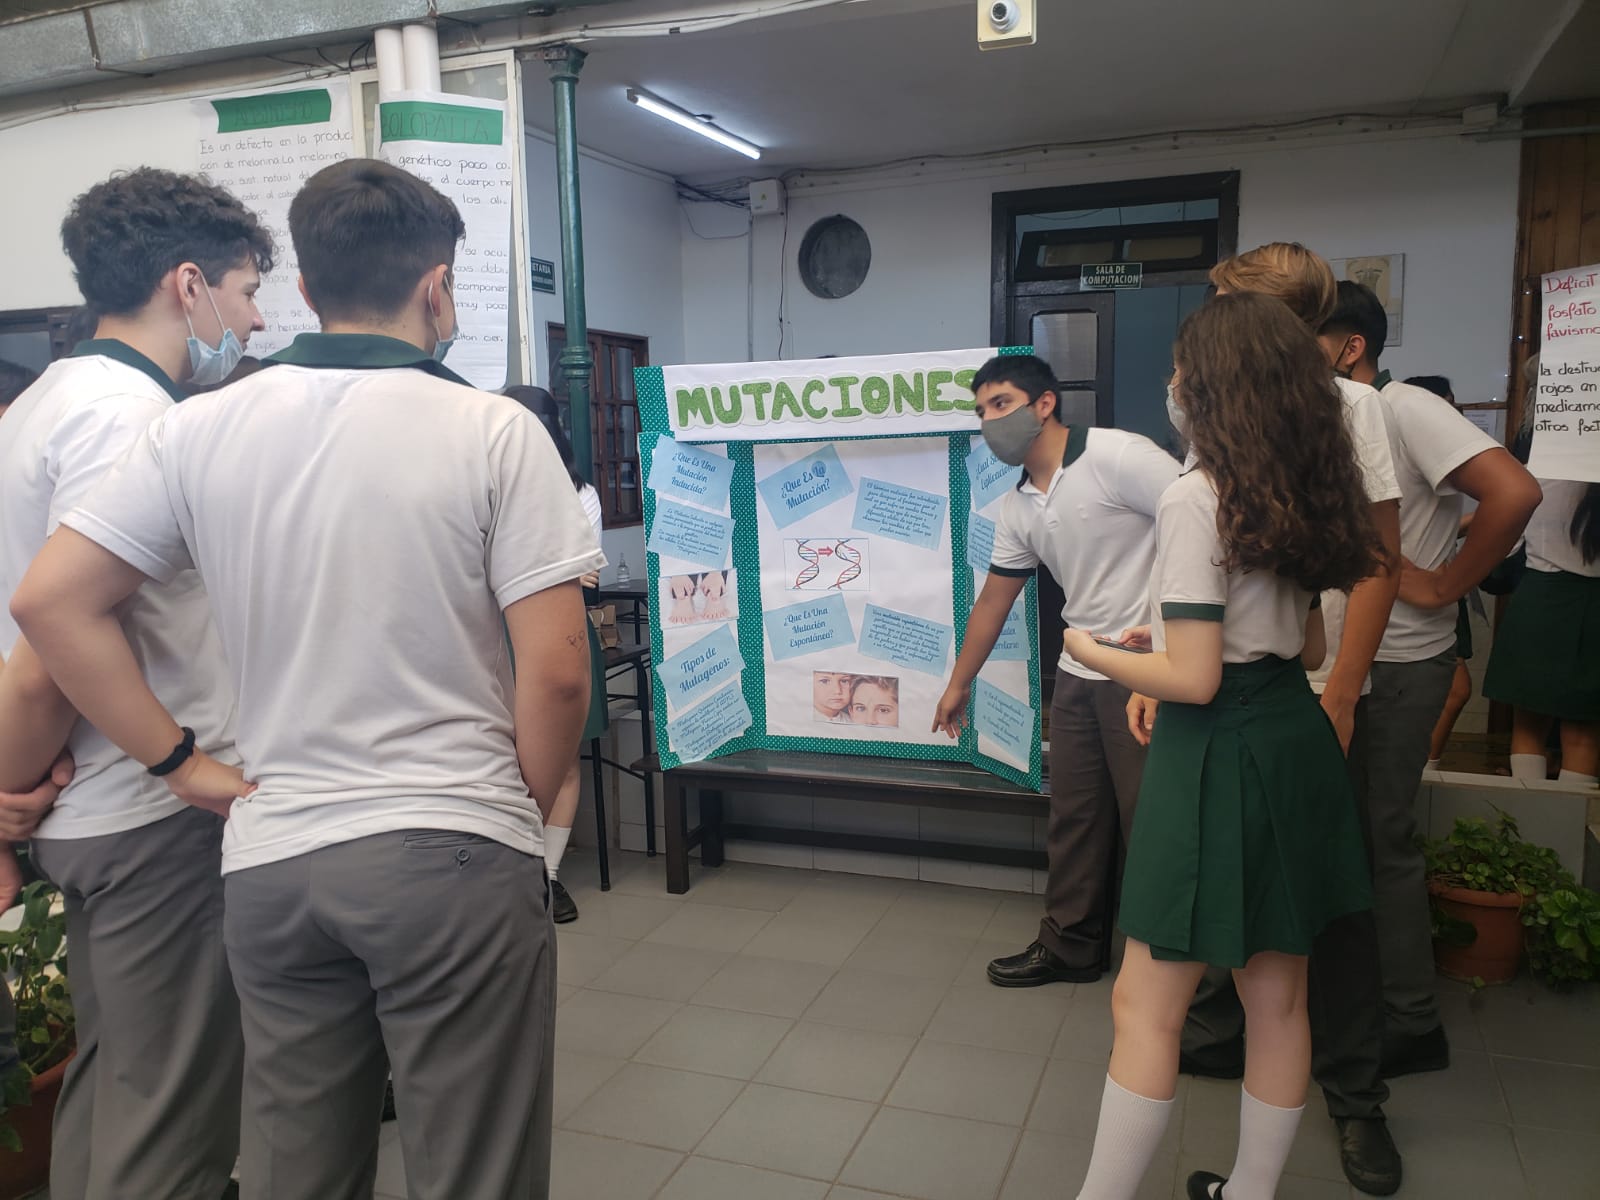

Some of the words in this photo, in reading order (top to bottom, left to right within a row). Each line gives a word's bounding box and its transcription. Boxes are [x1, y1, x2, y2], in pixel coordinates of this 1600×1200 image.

[200, 139, 214, 155] Es
[220, 142, 231, 151] un
[236, 136, 273, 150] defecto
[280, 138, 291, 147] en
[297, 134, 307, 144] la
[399, 153, 452, 168] genético
[460, 160, 488, 174] poco
[456, 177, 496, 188] cuerpo
[463, 193, 481, 204] los
[1095, 265, 1113, 275] SALA
[1115, 265, 1126, 274] DE
[1083, 274, 1139, 285] COMPUTACION
[1540, 362, 1551, 376] la
[1540, 382, 1573, 396] rojos
[1580, 382, 1597, 392] en
[675, 369, 978, 428] MUTACIONES
[1535, 419, 1569, 432] otros
[676, 465, 708, 482] Mutación
[691, 457, 700, 467] Es
[702, 460, 717, 473] Una
[781, 478, 801, 499] ¿Que
[803, 471, 814, 481] Es
[814, 463, 826, 477] La
[785, 478, 831, 511] Mutación?
[784, 612, 803, 626] ¿Que
[803, 610, 812, 620] Es
[813, 607, 828, 617] Una
[792, 620, 827, 634] Mutación
[790, 630, 834, 648] Espontánea?
[680, 655, 705, 673] Tipos
[705, 647, 717, 660] de
[679, 657, 730, 693] Mutagenos:
